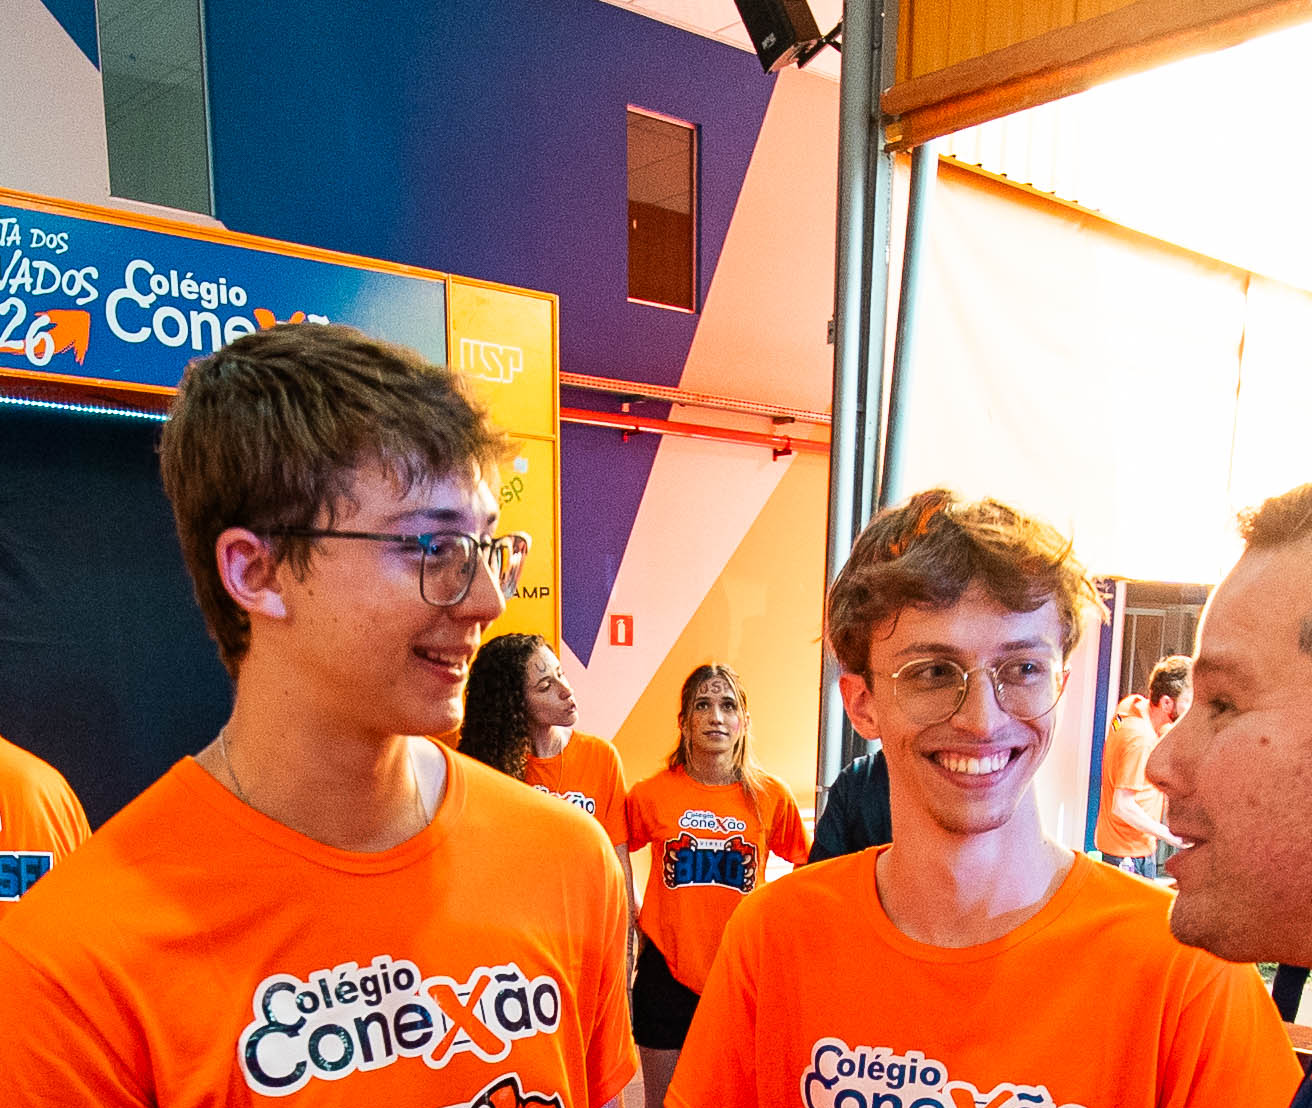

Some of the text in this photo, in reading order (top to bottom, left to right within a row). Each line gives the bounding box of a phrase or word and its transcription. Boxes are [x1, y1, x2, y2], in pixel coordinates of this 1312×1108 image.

[30, 228, 69, 254] DOS
[125, 259, 248, 309] Colégio
[459, 337, 524, 384] USP
[675, 849, 745, 888] BIXO
[262, 963, 415, 1030] Colégio
[815, 1044, 941, 1089] Colégio
